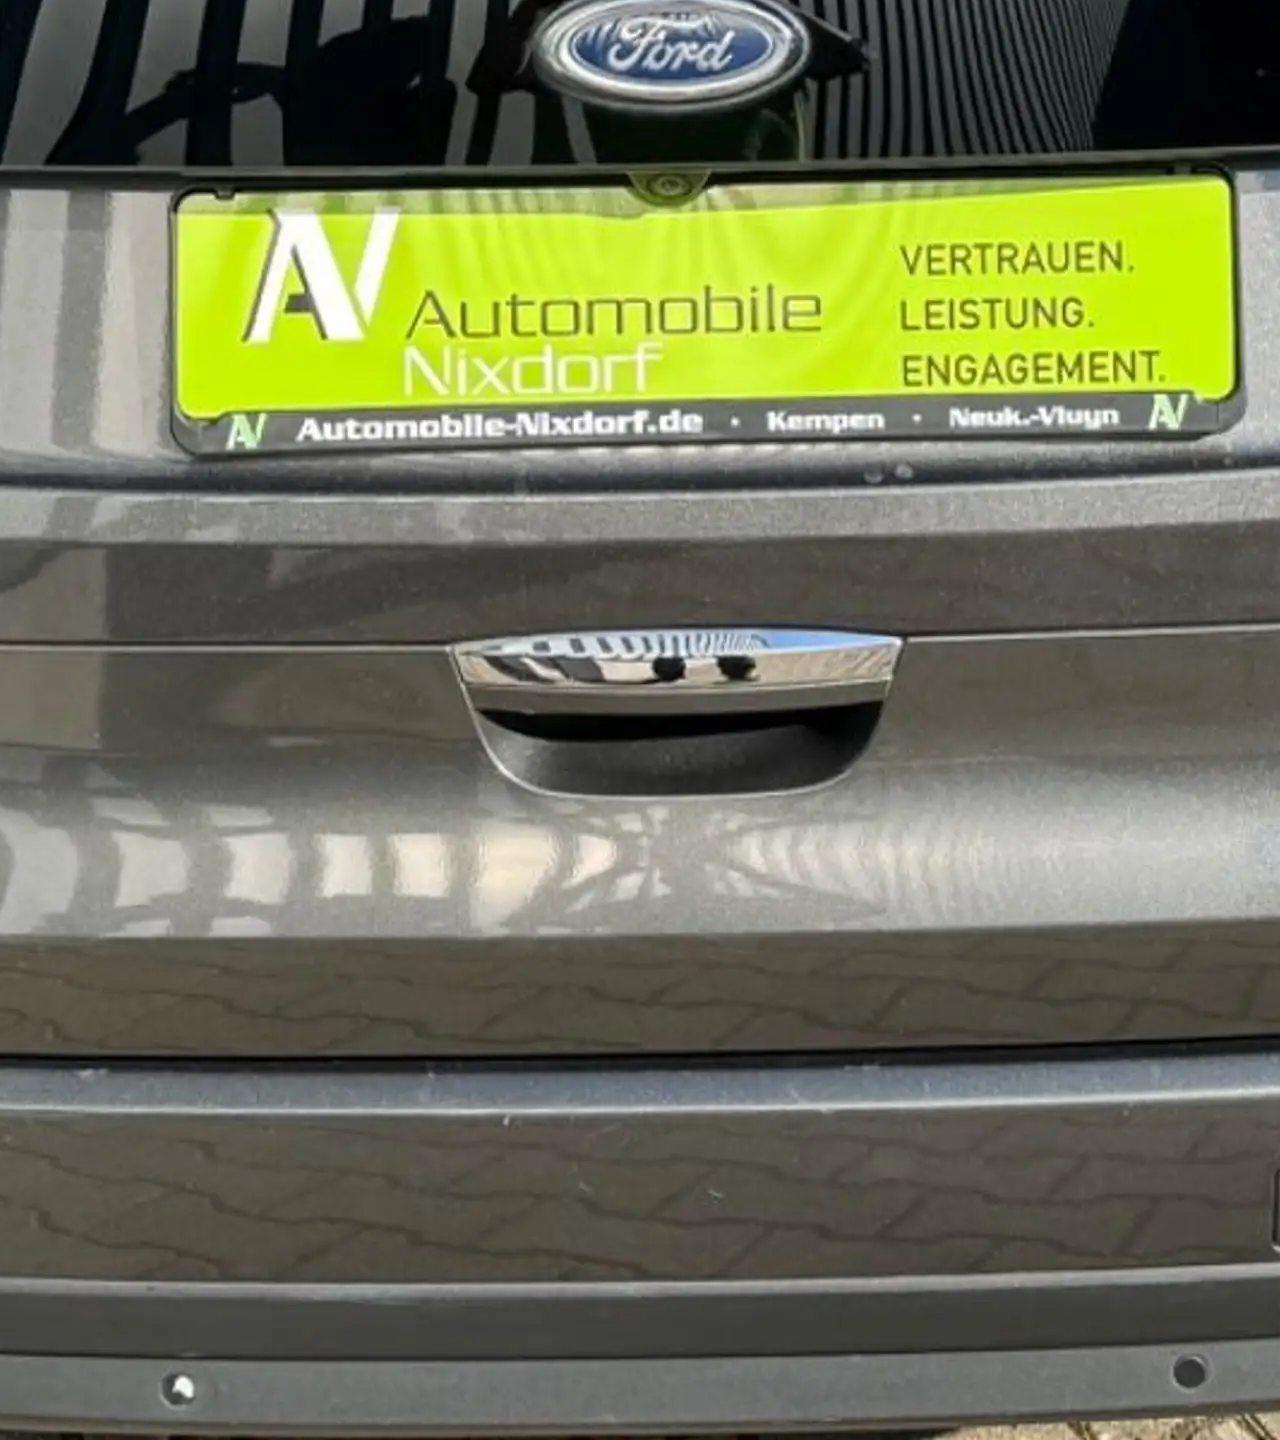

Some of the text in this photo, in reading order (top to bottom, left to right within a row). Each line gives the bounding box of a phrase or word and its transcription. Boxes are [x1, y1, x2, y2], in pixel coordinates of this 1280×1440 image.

[607, 14, 736, 72] Ford
[900, 241, 1135, 276] VERTRAUEN.
[405, 284, 822, 339] Automobile
[900, 298, 1095, 331] LEISTUNG.
[404, 340, 664, 398] Nixdorf
[902, 350, 1166, 388] ENGAGEMENT.
[296, 410, 703, 442] Automobile-Nixdorf.de
[767, 410, 885, 434] Kempen
